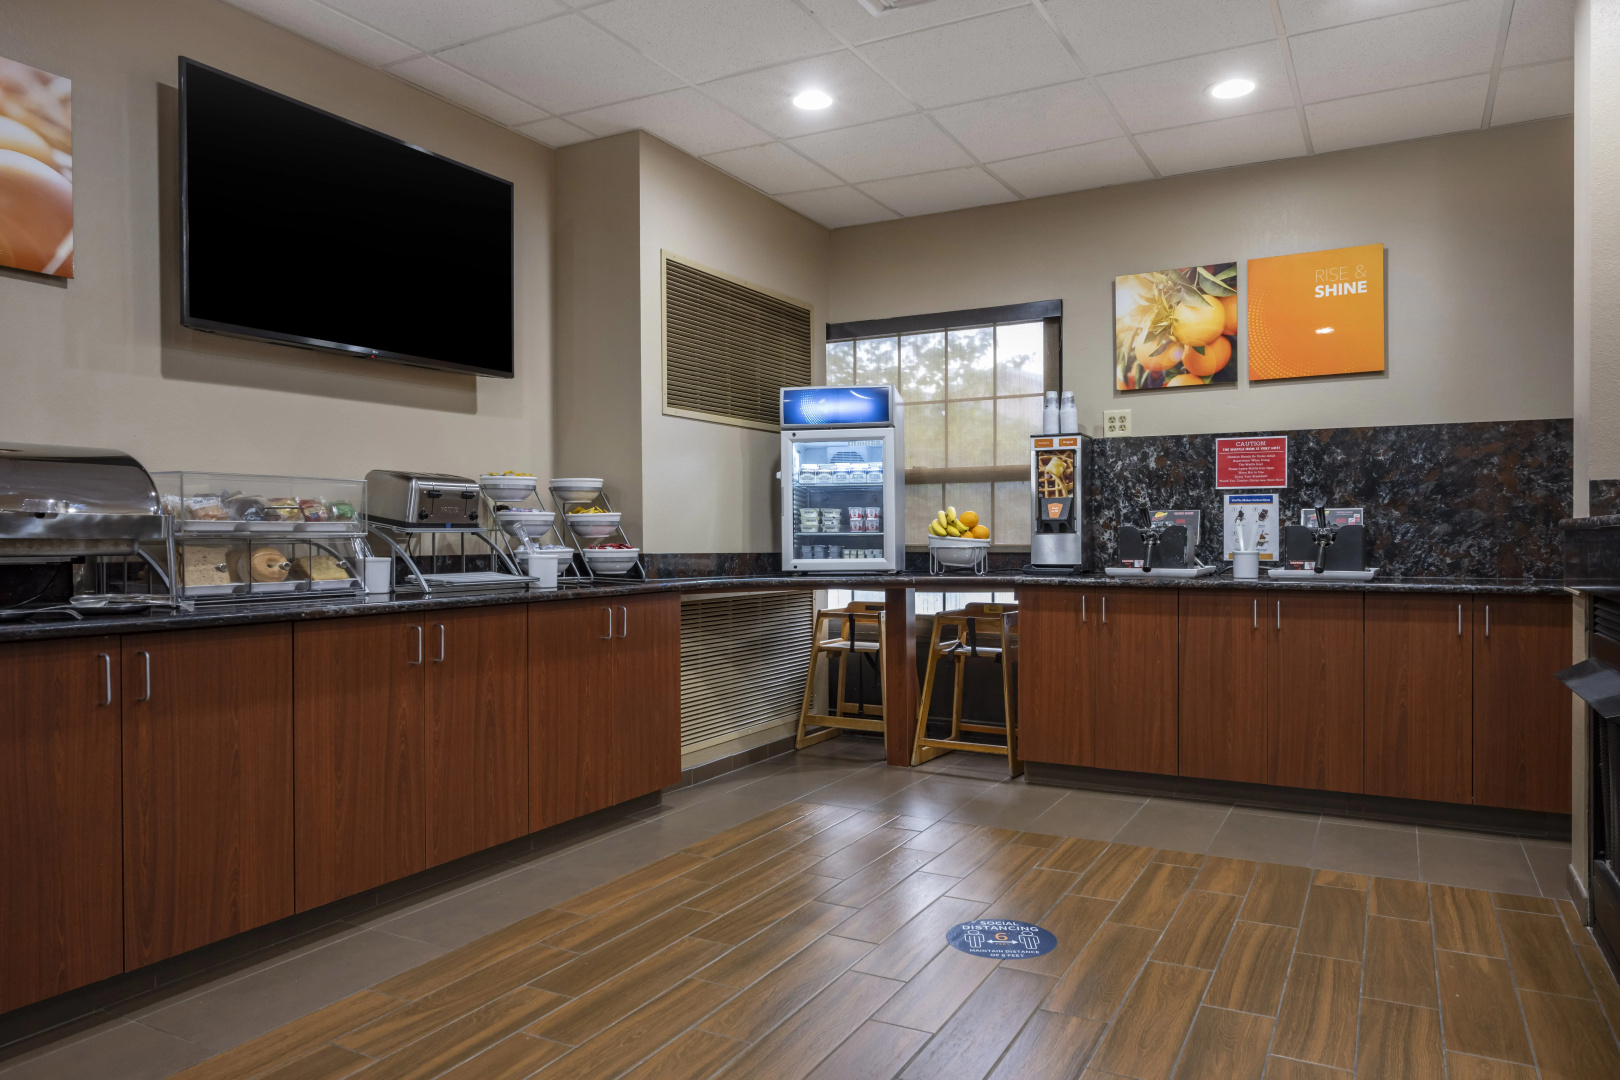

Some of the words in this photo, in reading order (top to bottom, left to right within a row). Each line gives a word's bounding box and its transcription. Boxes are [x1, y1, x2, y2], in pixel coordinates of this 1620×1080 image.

[1315, 266, 1349, 282] RISE
[1354, 264, 1367, 279] &
[1314, 280, 1368, 298] SHINE
[995, 932, 1008, 941] 6
